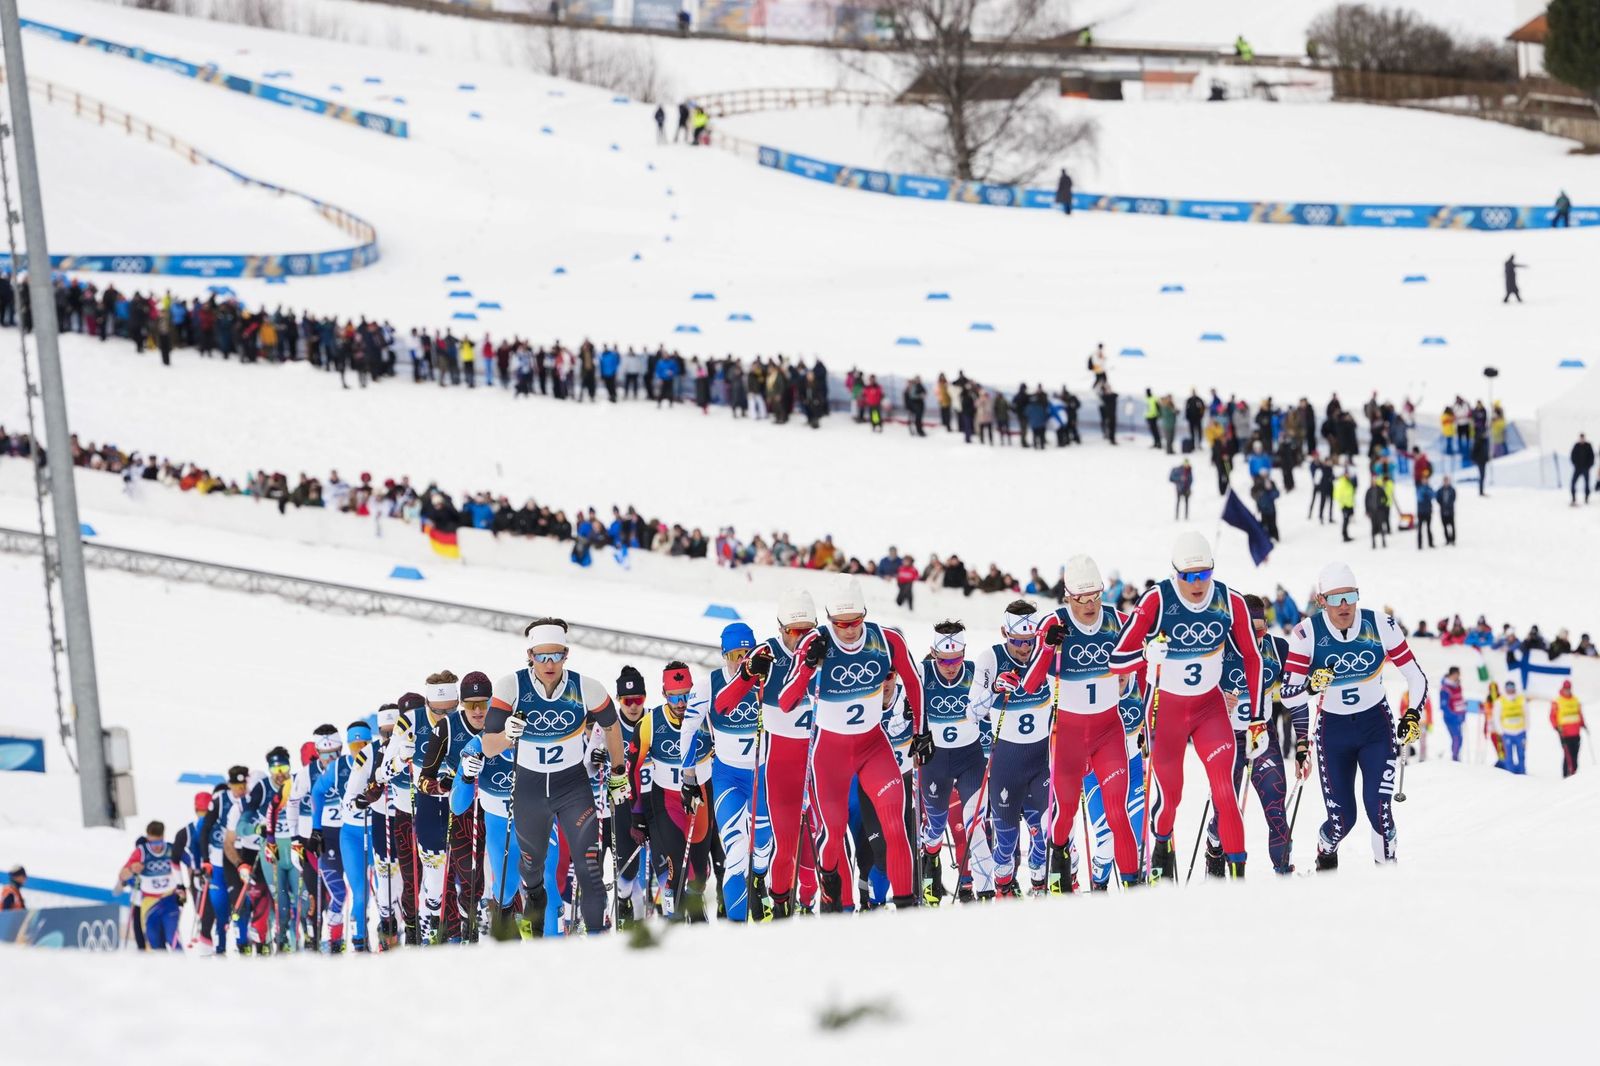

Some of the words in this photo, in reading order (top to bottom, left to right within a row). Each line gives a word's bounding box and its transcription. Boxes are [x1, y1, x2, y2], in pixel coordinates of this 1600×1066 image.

[1183, 663, 1203, 686] 3
[1086, 683, 1097, 705] 1
[1341, 687, 1361, 706] 5
[794, 710, 812, 731] 4
[846, 703, 865, 726] 2
[1237, 702, 1251, 722] 9
[1018, 713, 1035, 735] 8
[943, 726, 958, 743] 6
[535, 745, 564, 765] 12
[738, 737, 755, 756] 7
[1206, 744, 1226, 762] CRAFT
[640, 768, 652, 786] 8
[1102, 770, 1120, 786] CRAFT
[1378, 759, 1397, 796] USA
[877, 780, 896, 797] CRAFT
[151, 878, 170, 889] 52
